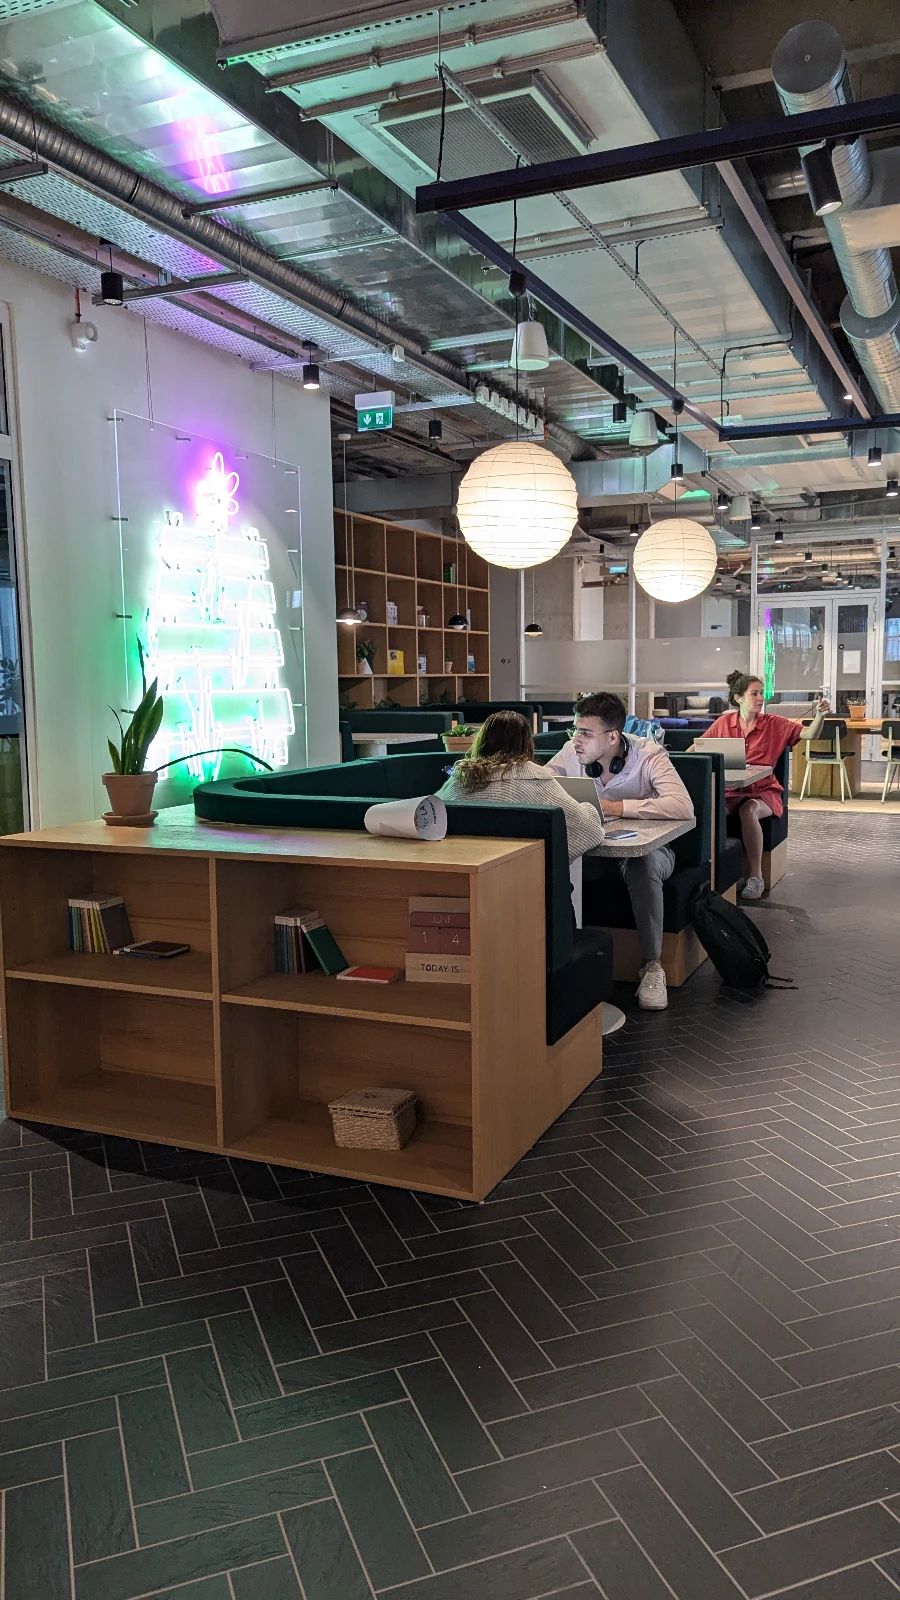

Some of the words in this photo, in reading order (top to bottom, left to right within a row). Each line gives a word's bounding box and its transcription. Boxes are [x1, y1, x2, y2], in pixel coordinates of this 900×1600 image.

[420, 931, 427, 944] 1
[451, 934, 461, 945] 4
[420, 963, 449, 973] TODAY
[451, 965, 460, 974] IS
